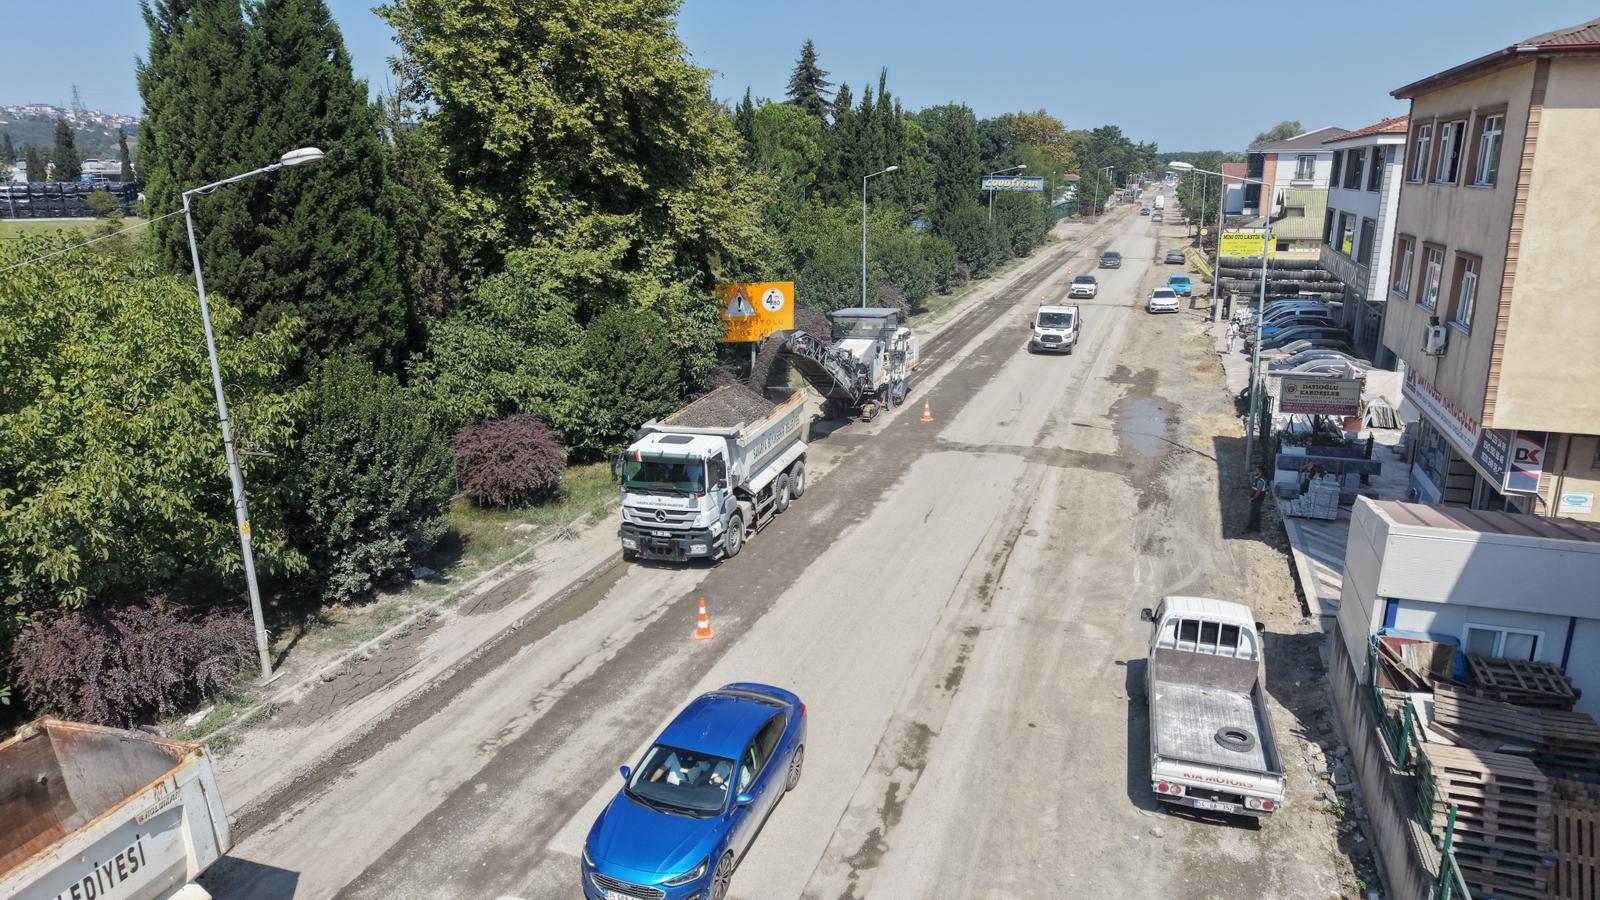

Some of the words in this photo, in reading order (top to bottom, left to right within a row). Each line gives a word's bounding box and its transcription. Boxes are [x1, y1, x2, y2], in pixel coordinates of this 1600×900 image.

[766, 294, 773, 305] 4
[1515, 447, 1541, 461] DK
[1206, 775, 1254, 788] MOTORS
[57, 834, 146, 900] EDİYESİ
